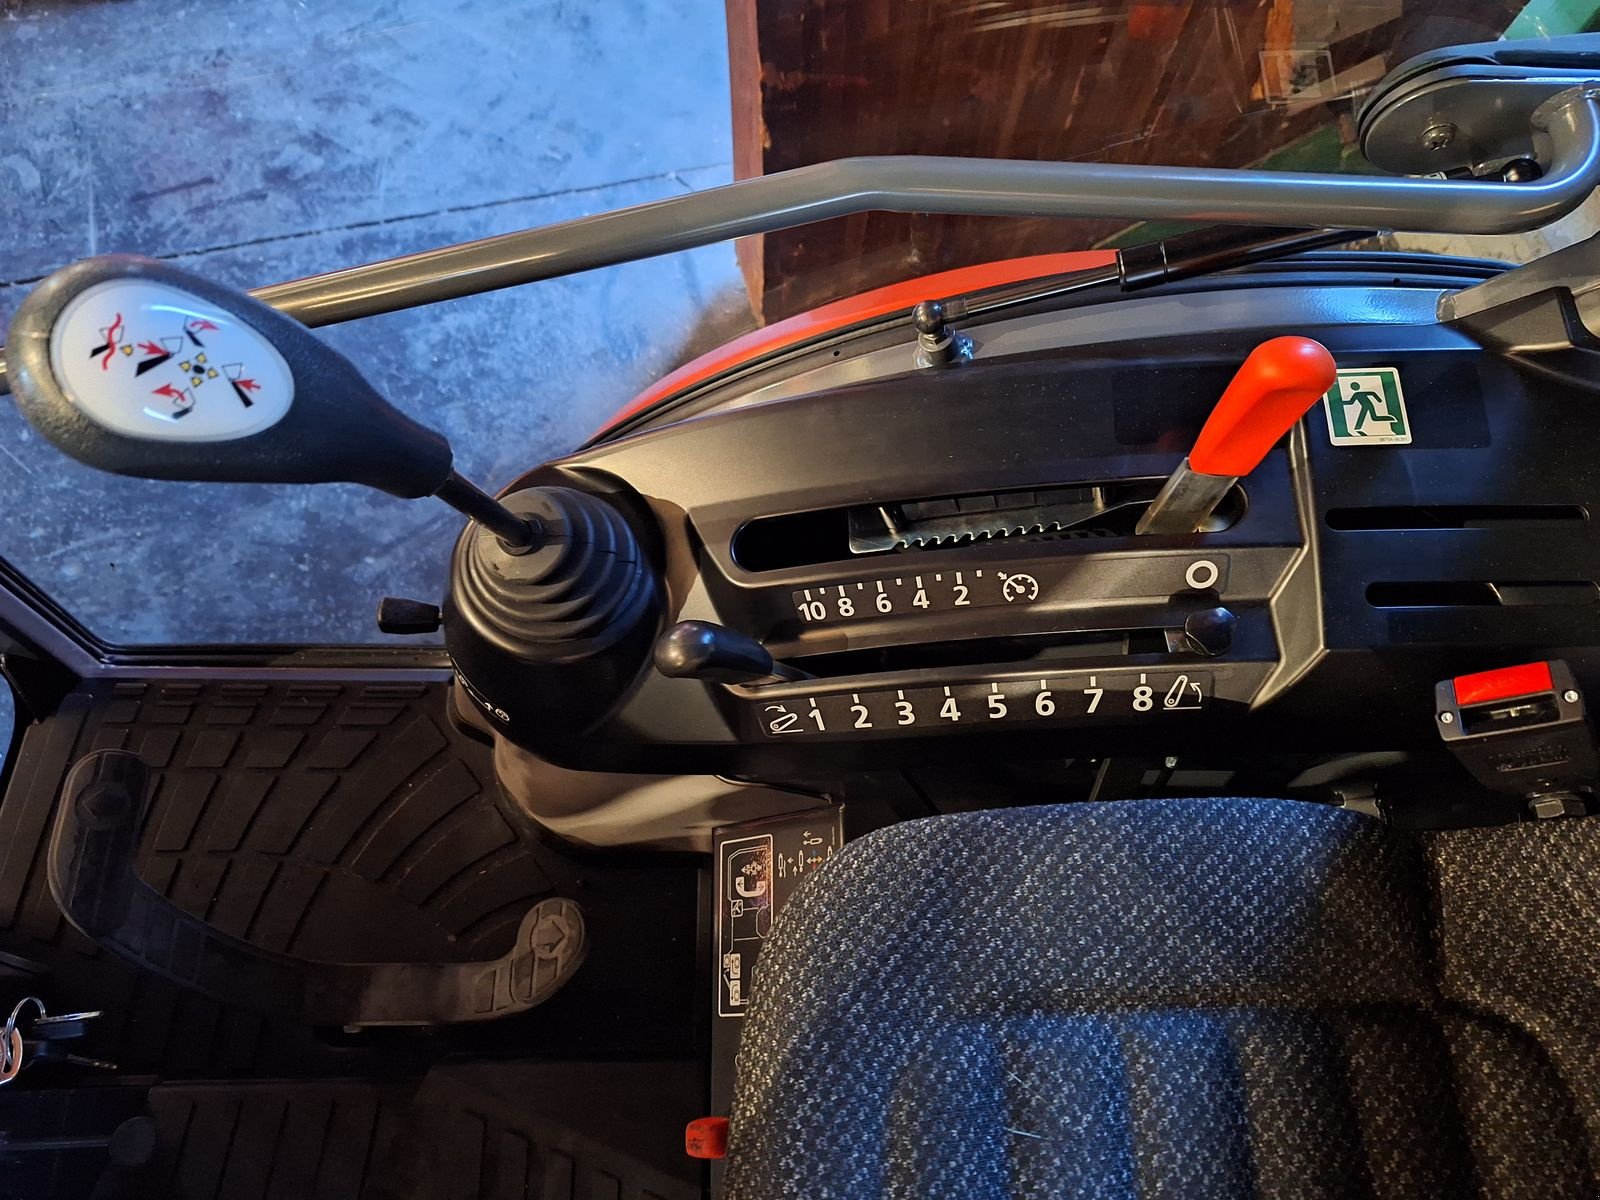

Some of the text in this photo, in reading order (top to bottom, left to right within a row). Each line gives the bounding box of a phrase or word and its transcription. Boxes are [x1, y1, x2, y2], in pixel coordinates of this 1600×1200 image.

[797, 585, 971, 621] 10 8 6 4 2
[808, 685, 1153, 731] 1 2 3 4 5 6 7 8
